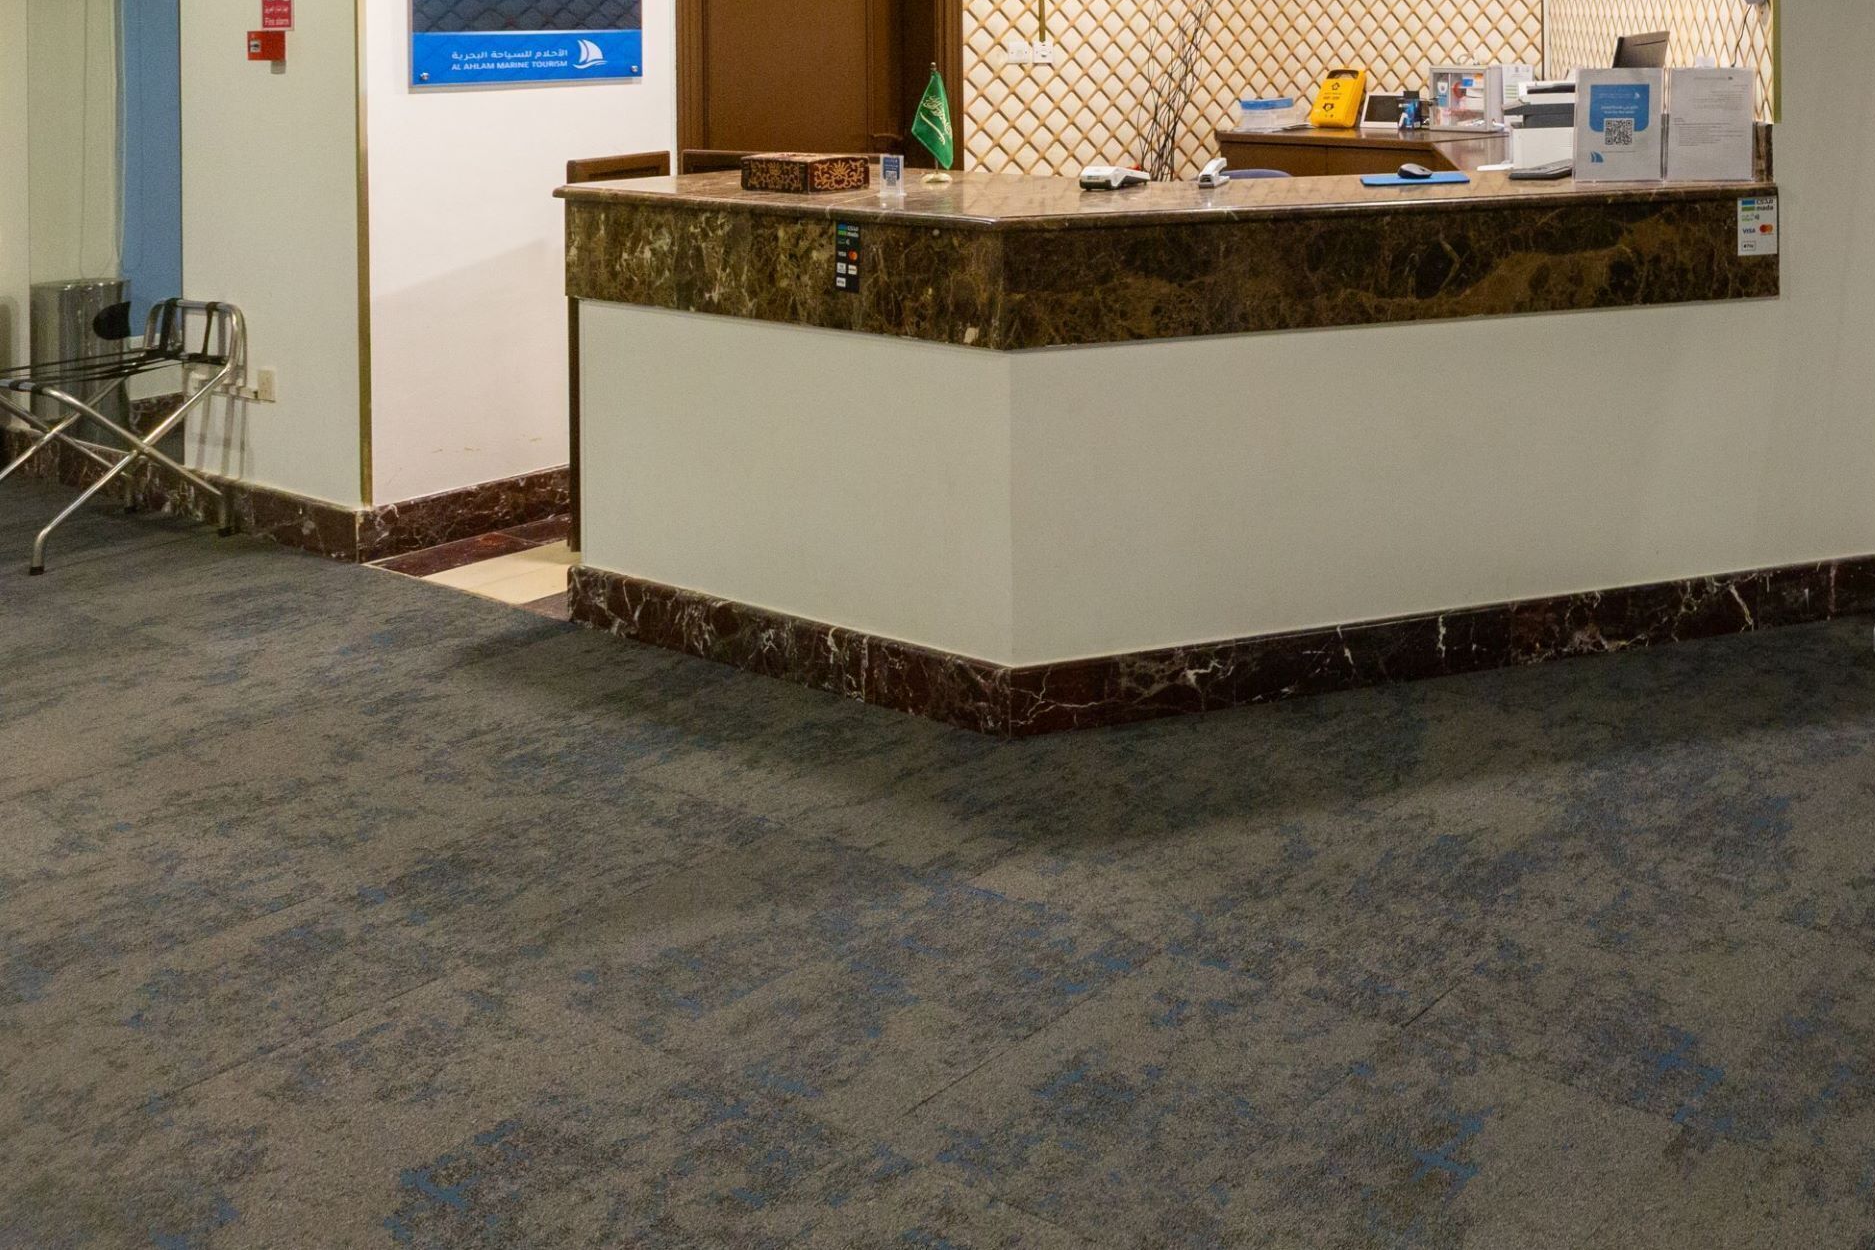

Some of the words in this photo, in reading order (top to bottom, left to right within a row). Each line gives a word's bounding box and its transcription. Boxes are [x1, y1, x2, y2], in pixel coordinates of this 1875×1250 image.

[451, 50, 488, 61] البحرية
[490, 50, 533, 61] للسياحة
[452, 63, 462, 71] AL
[463, 62, 495, 70] AHLAM
[496, 61, 530, 69] MARINE
[531, 60, 568, 68] TOURISM
